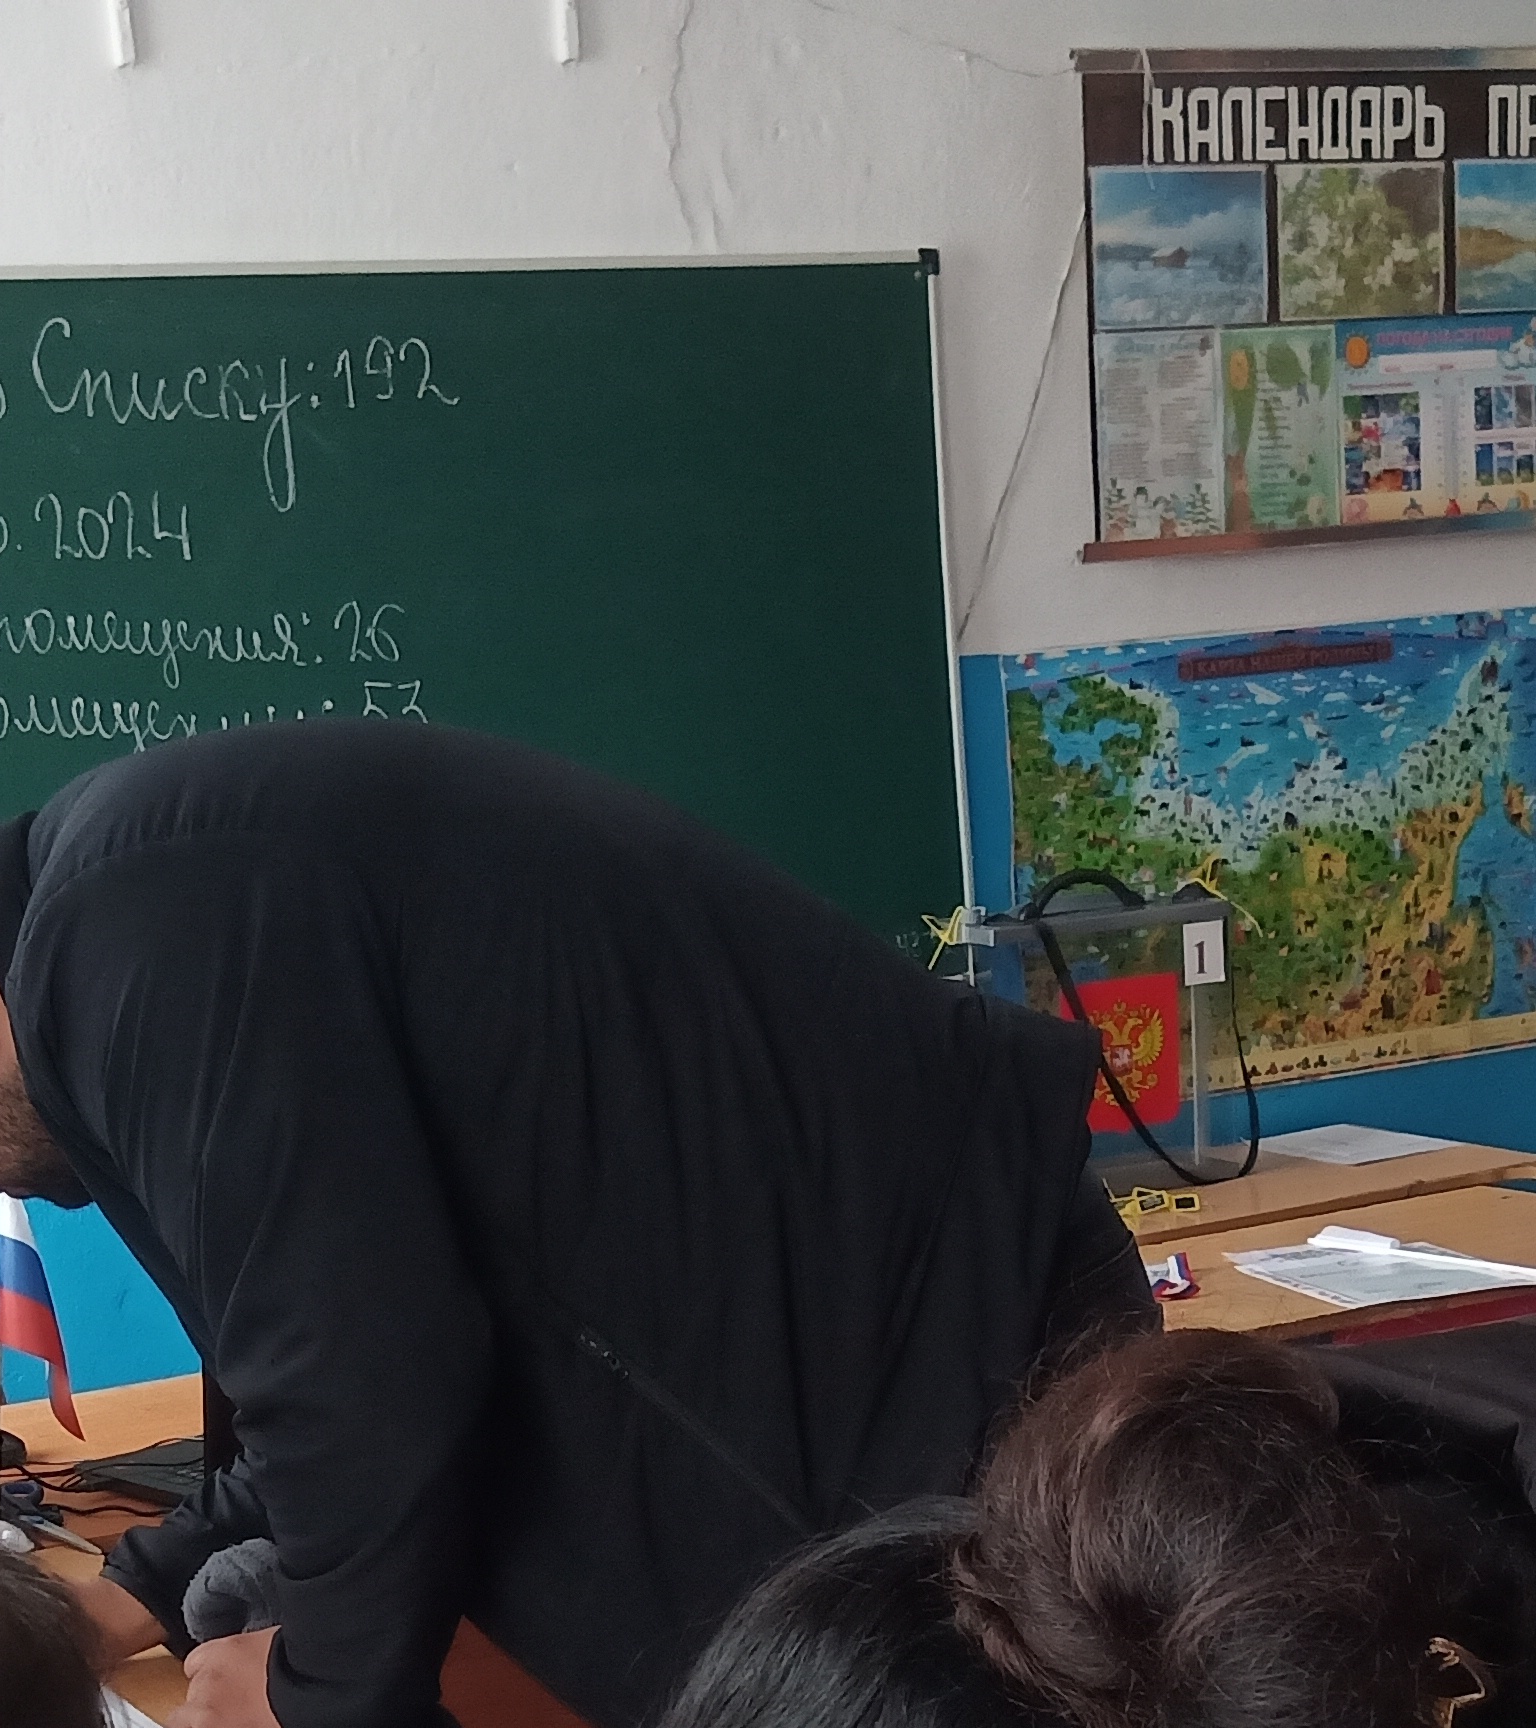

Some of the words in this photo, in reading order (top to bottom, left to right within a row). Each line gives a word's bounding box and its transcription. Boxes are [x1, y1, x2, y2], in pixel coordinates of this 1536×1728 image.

[1149, 83, 1446, 162] КАЛЕНДАРЬ
[333, 336, 460, 410] 192
[333, 601, 405, 662] 26
[1192, 938, 1210, 976] 1
